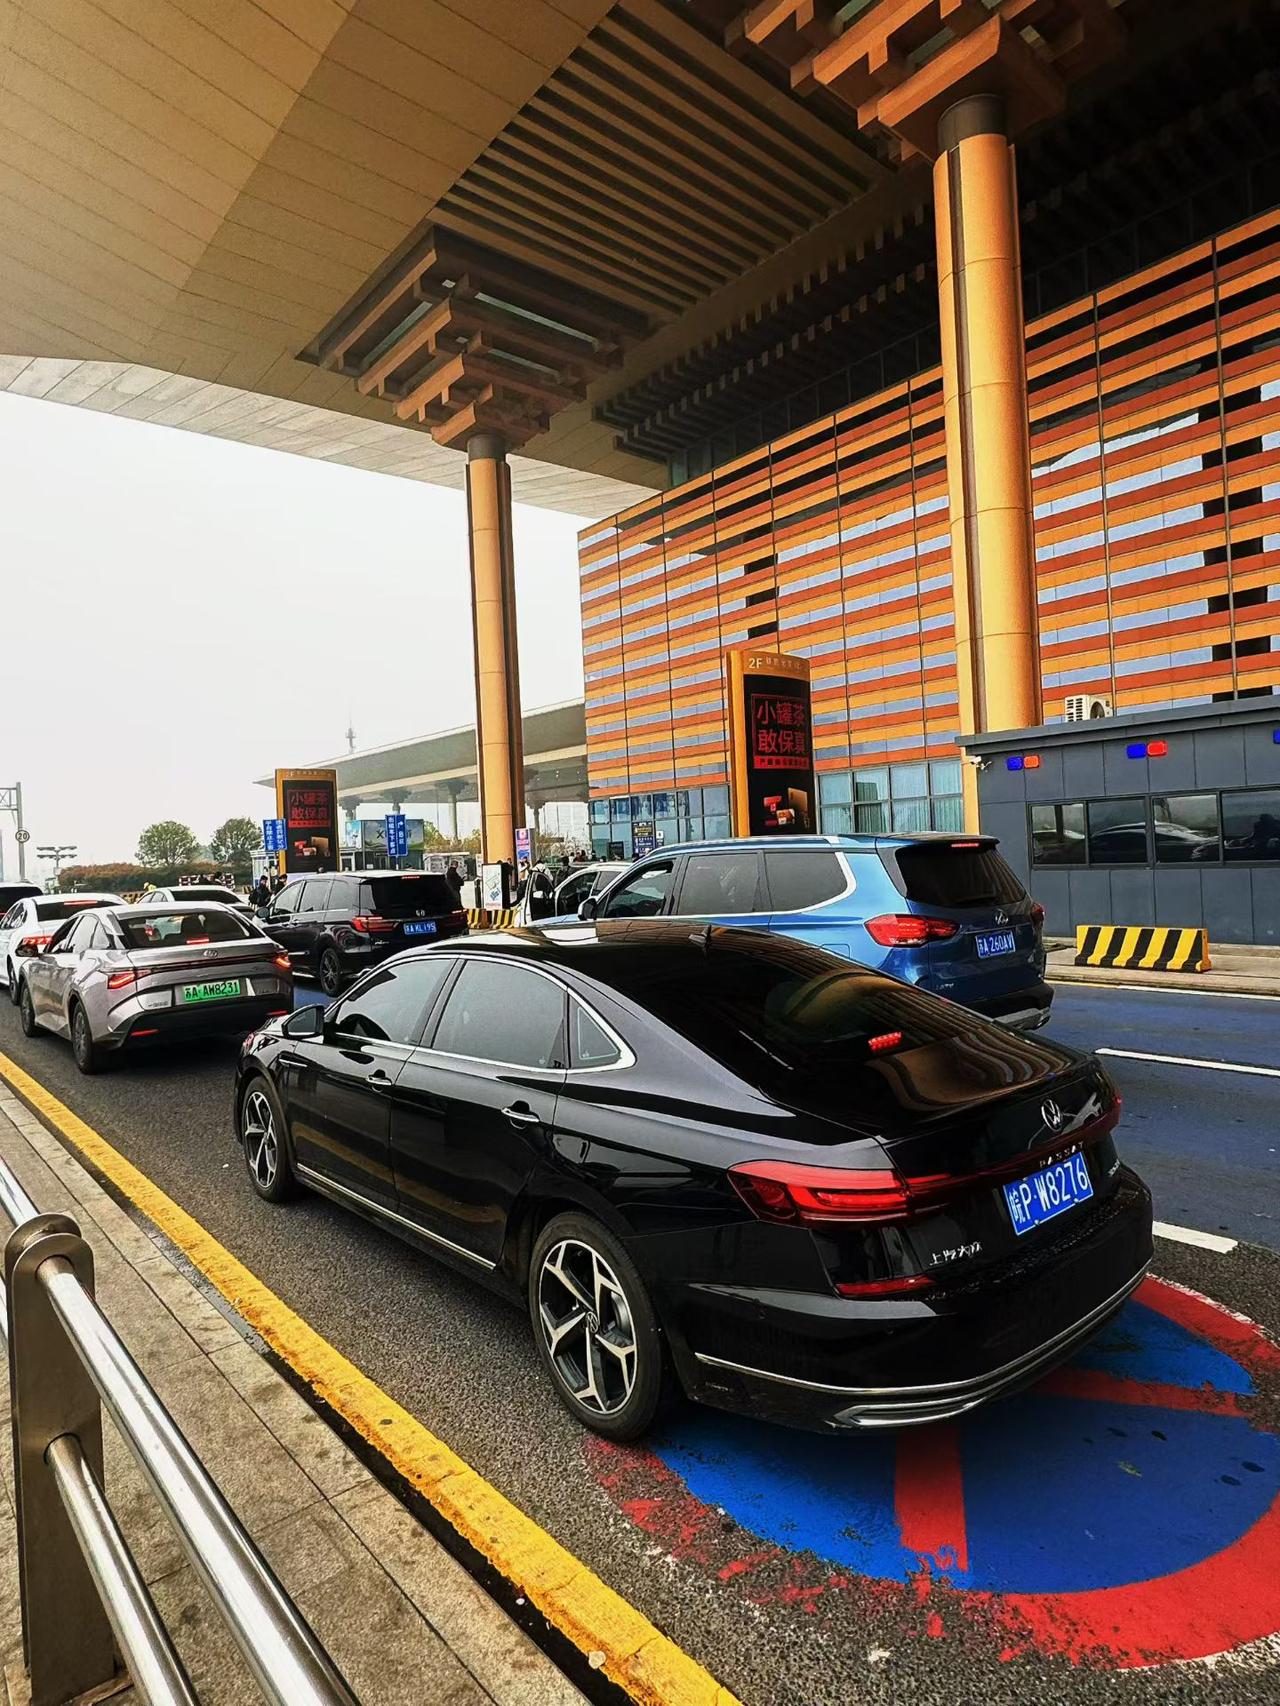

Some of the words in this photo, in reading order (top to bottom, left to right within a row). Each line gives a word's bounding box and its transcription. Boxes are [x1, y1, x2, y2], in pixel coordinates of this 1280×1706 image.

[748, 657, 763, 669] 2F
[757, 700, 805, 727] 小罐茶
[757, 728, 805, 754] 敢保真
[18, 832, 28, 840] 20
[1039, 1141, 1085, 1168] PASSAT
[929, 1240, 983, 1266] 上汽大众
